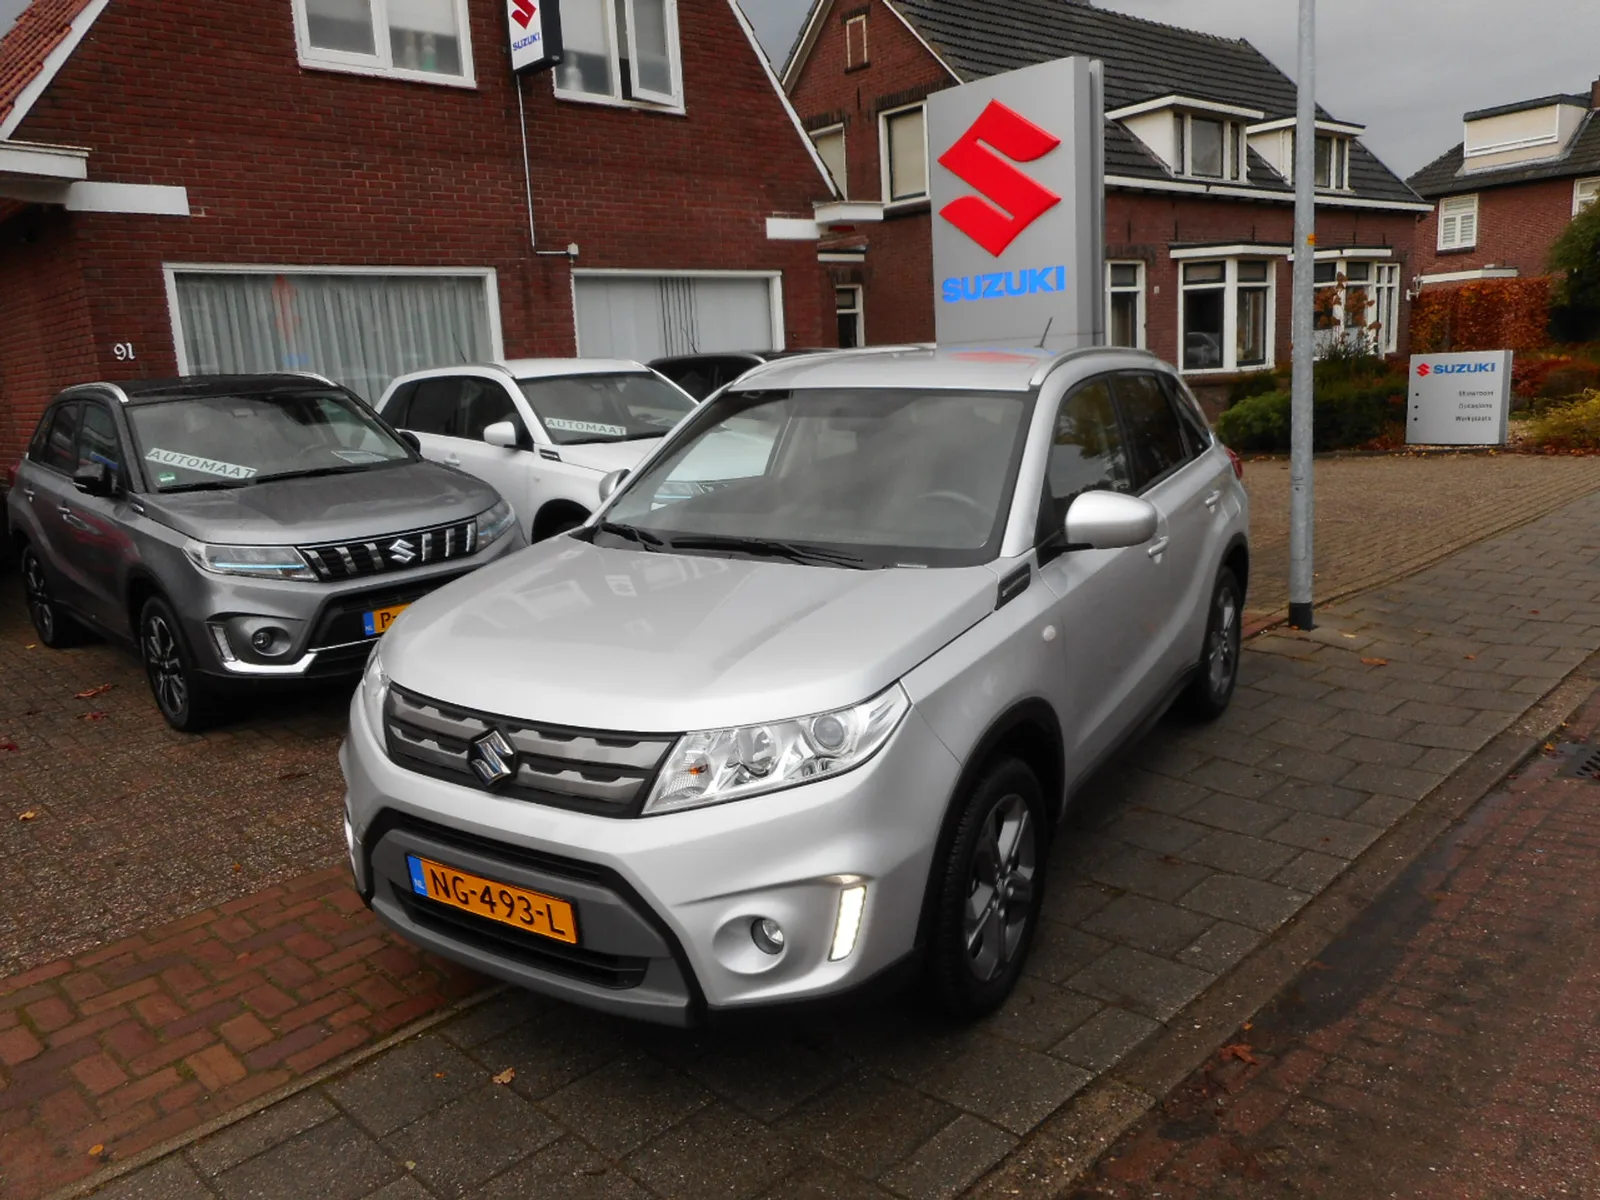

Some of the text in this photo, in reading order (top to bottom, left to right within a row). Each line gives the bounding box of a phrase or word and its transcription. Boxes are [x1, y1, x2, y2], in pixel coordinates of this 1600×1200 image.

[512, 32, 540, 51] SUZUKI
[942, 265, 1065, 303] SUZUKI
[113, 342, 136, 361] 91
[1433, 362, 1496, 374] SUZUKI
[544, 418, 625, 436] AUTOMAAT
[147, 450, 256, 479] AUTOMAAT
[430, 867, 566, 936] NG-493-L
